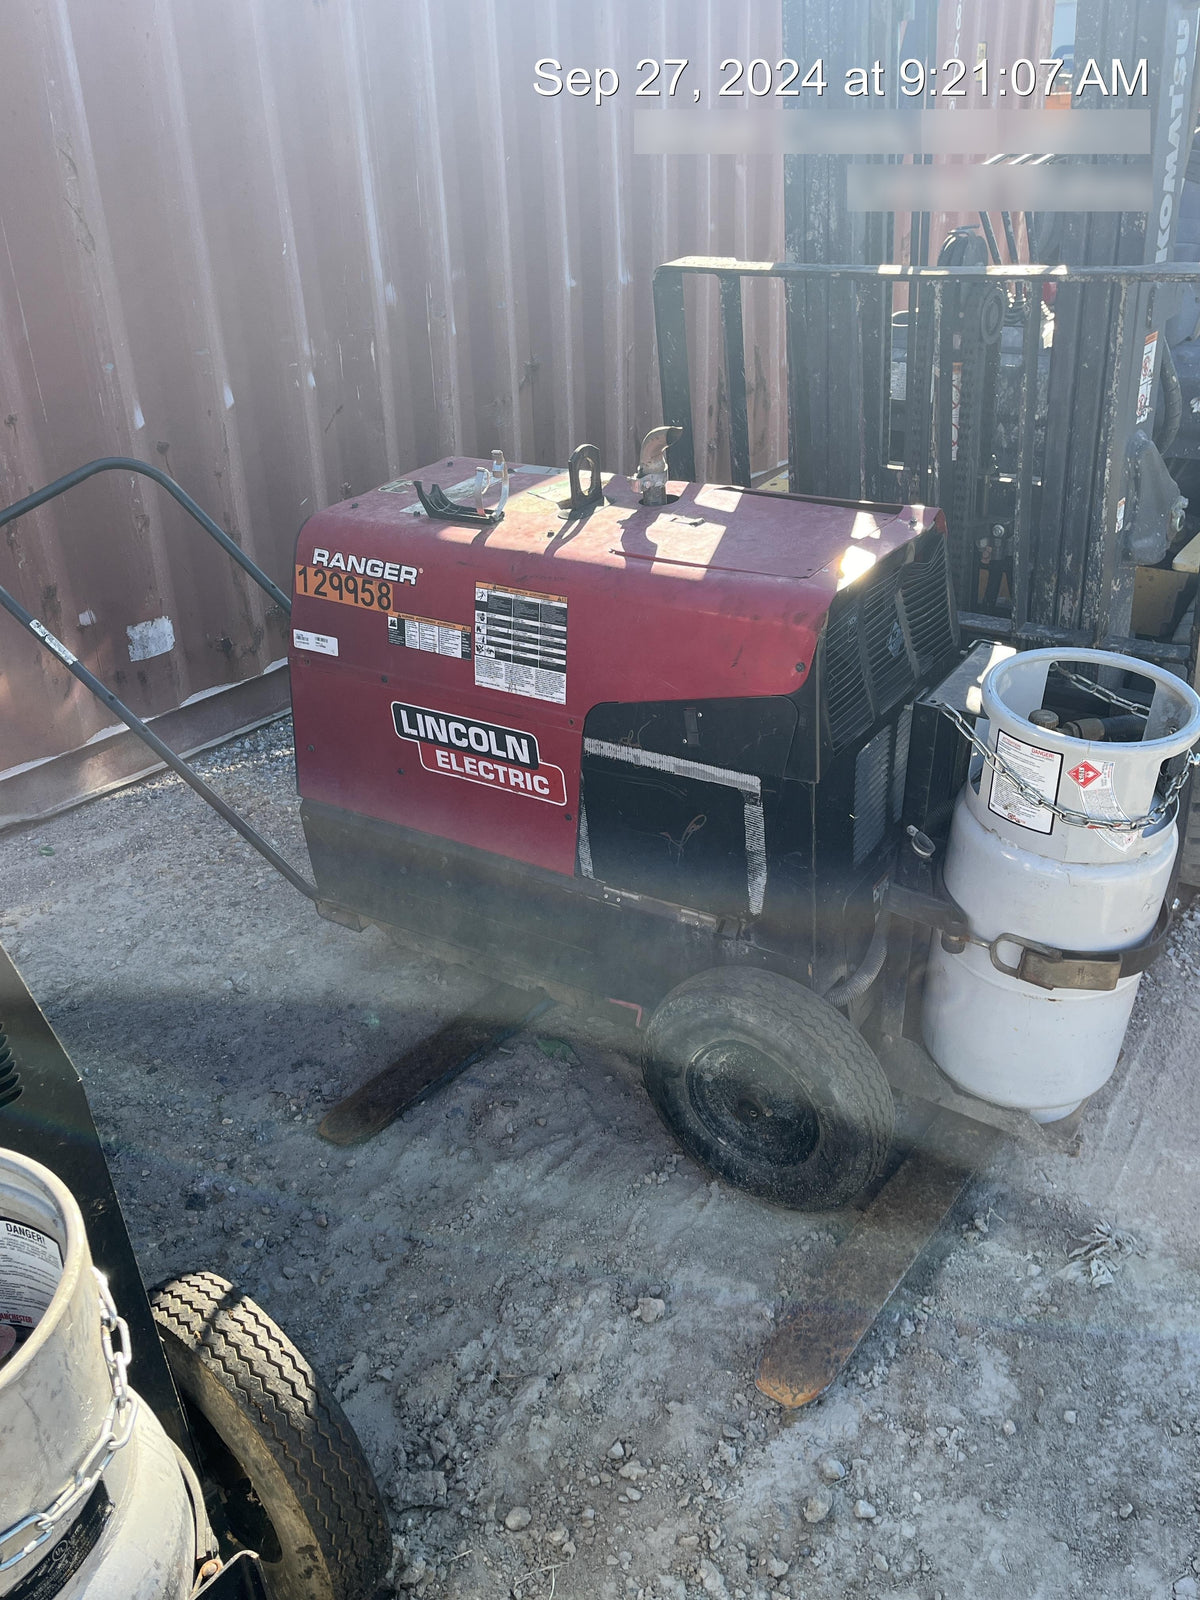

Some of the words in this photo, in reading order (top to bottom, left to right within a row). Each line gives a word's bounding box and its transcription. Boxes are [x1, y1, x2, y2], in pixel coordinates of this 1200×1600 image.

[1154, 19, 1190, 264] KOMATSU
[297, 566, 392, 611] 129958
[312, 548, 418, 585] RANGER
[400, 708, 531, 765] LINCOLN
[435, 748, 550, 796] ELECTRIC
[6, 1223, 45, 1245] DANGER!
[0, 1312, 32, 1323] ANCHESTER
